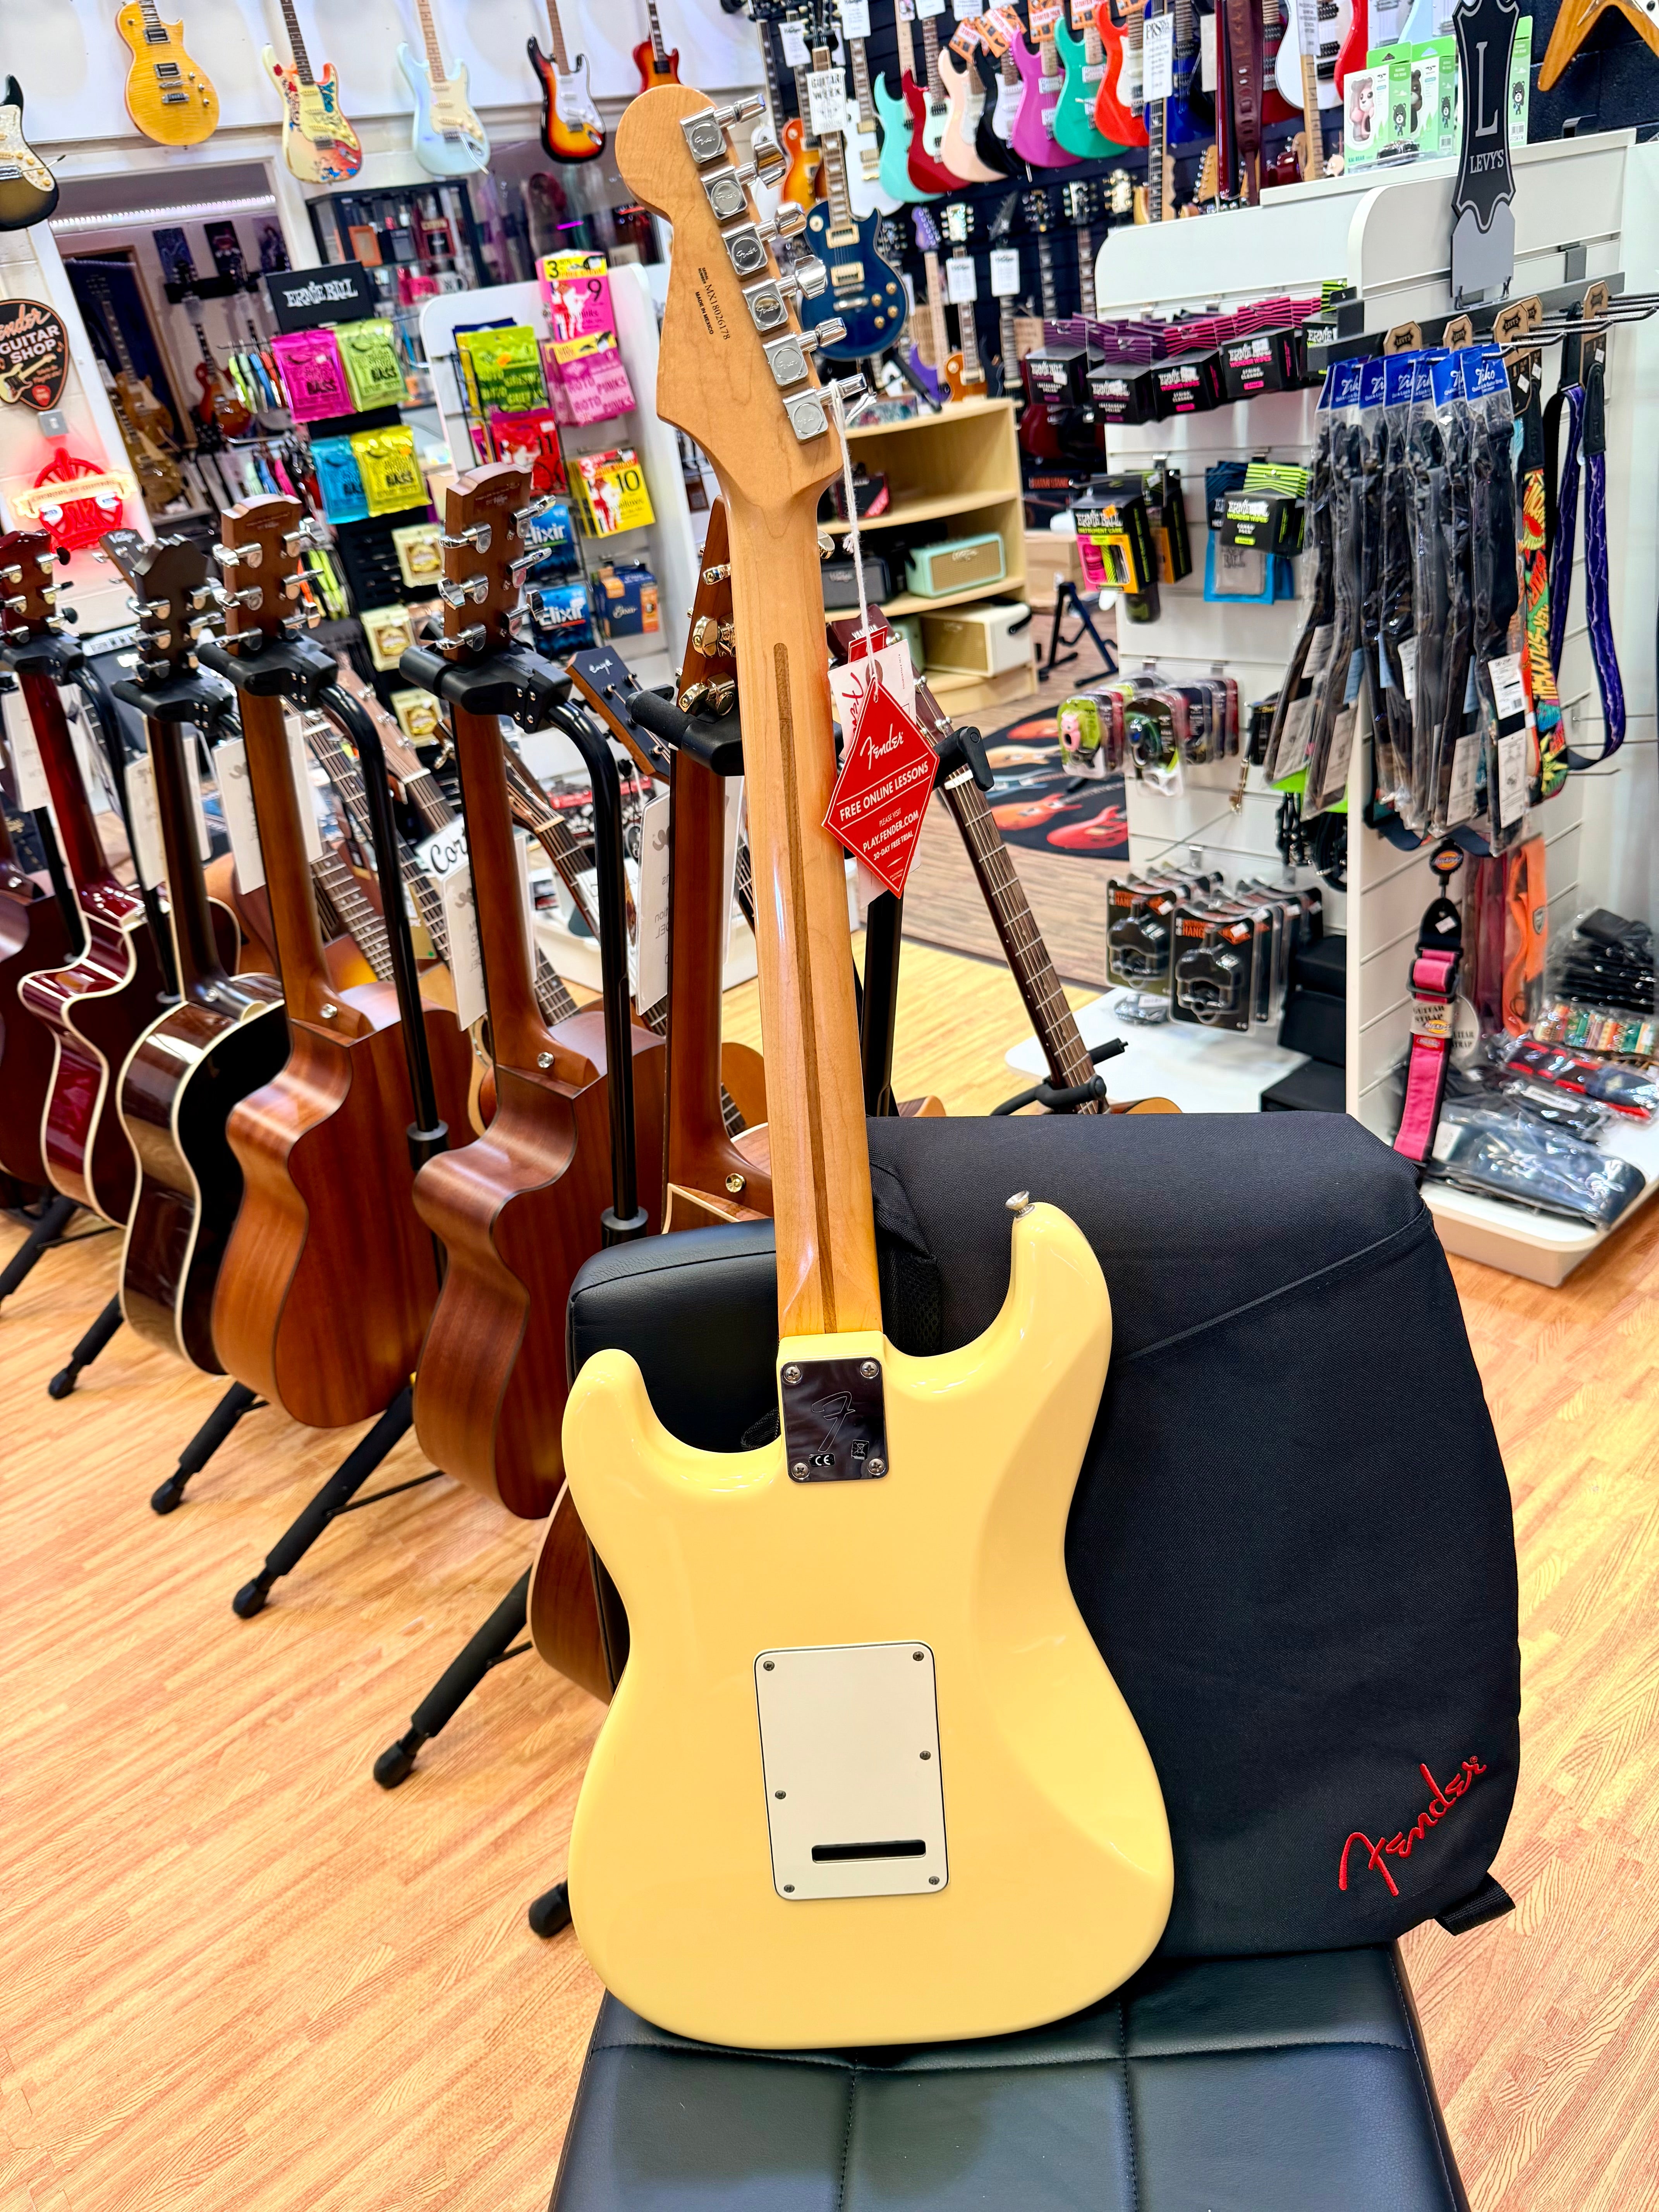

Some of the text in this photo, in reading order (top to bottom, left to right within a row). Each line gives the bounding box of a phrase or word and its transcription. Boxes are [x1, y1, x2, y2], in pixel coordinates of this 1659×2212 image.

[1475, 41, 1498, 137] L
[1470, 149, 1504, 174] LEVY'S
[548, 260, 559, 278] 3
[283, 278, 359, 307] ERNIE BALL
[588, 279, 601, 302] 9
[0, 304, 52, 341] ender
[695, 292, 704, 307] MADE
[703, 314, 714, 335] MEXICO
[705, 284, 731, 340] MX18026178
[0, 325, 60, 355] GUITAR
[1307, 326, 1333, 343] ERNIE
[10, 339, 57, 364] SHOP
[1341, 374, 1359, 396] Tik
[1475, 362, 1495, 385] Tiko
[539, 436, 553, 456] 11
[581, 459, 596, 478] 3
[616, 470, 639, 493] 10
[1075, 509, 1100, 527] ERNIE
[539, 605, 586, 627] Elixir
[860, 723, 904, 771] Fender
[840, 760, 929, 822] FREE ONLINE LESSONS
[879, 807, 902, 828] PLEASE VISIT
[863, 809, 919, 853] PLAY.FENDER.COM
[873, 830, 914, 861] 30-DAY FREE TRIAL
[1453, 1030, 1474, 1038] UITAR
[1338, 1757, 1487, 1897] Fender
